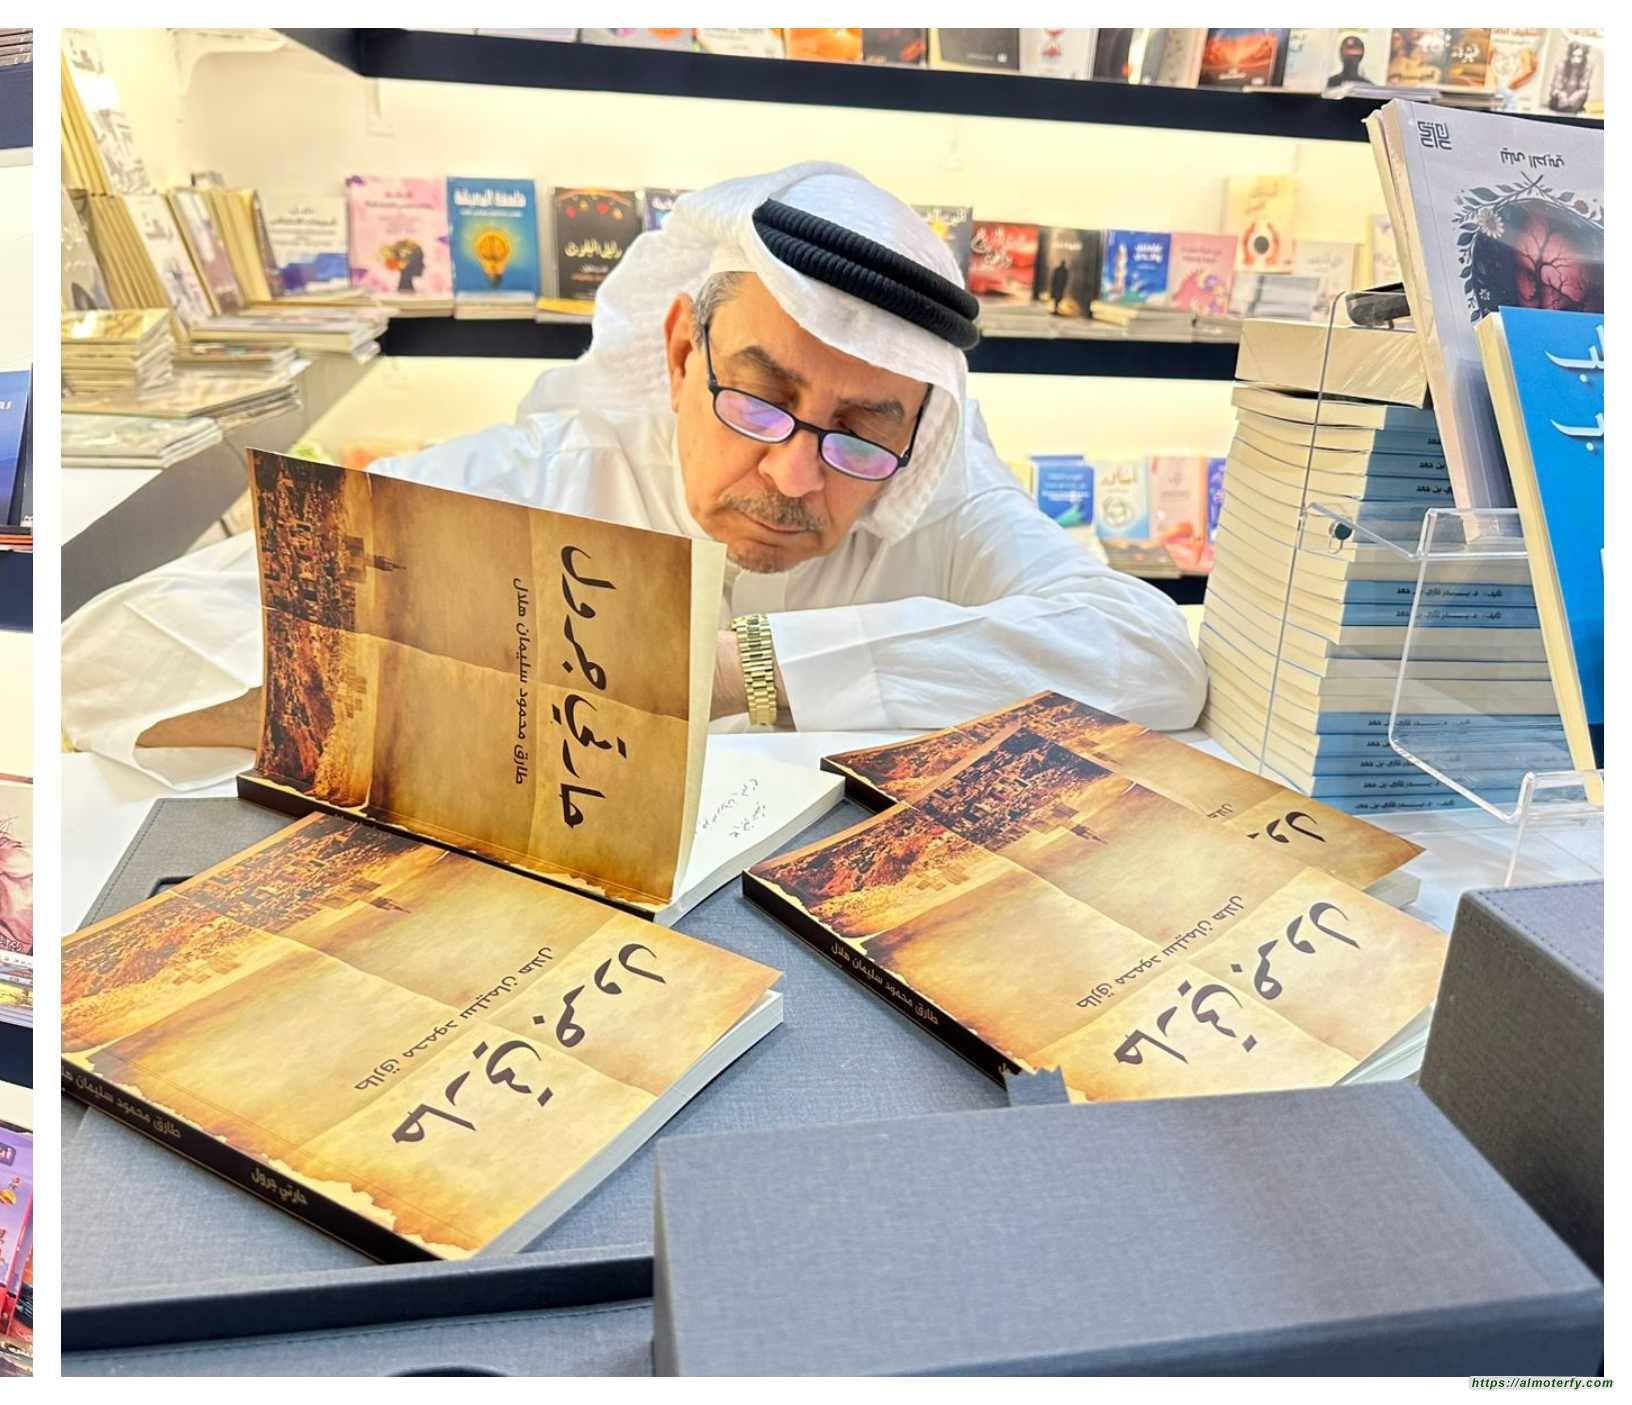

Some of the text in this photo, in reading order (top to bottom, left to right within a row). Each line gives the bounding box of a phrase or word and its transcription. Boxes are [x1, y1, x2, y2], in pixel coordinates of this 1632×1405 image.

[512, 577, 531, 785] طارق محمود سليمان هلال
[551, 545, 627, 828] حارتي جرول
[831, 942, 939, 1025] طارق محمود سليمان هلال
[1076, 895, 1246, 1008] طارق محمود سليمان هلال
[1113, 902, 1361, 1065] حارتي جرول
[354, 946, 553, 1090] طارق محمود سليمان هلال
[390, 943, 667, 1144] حارتي جرول
[75, 1077, 114, 1102] سليمان
[117, 1098, 152, 1123] محمود
[152, 1117, 182, 1139] طارق
[250, 1168, 307, 1205] حارتي جرول
